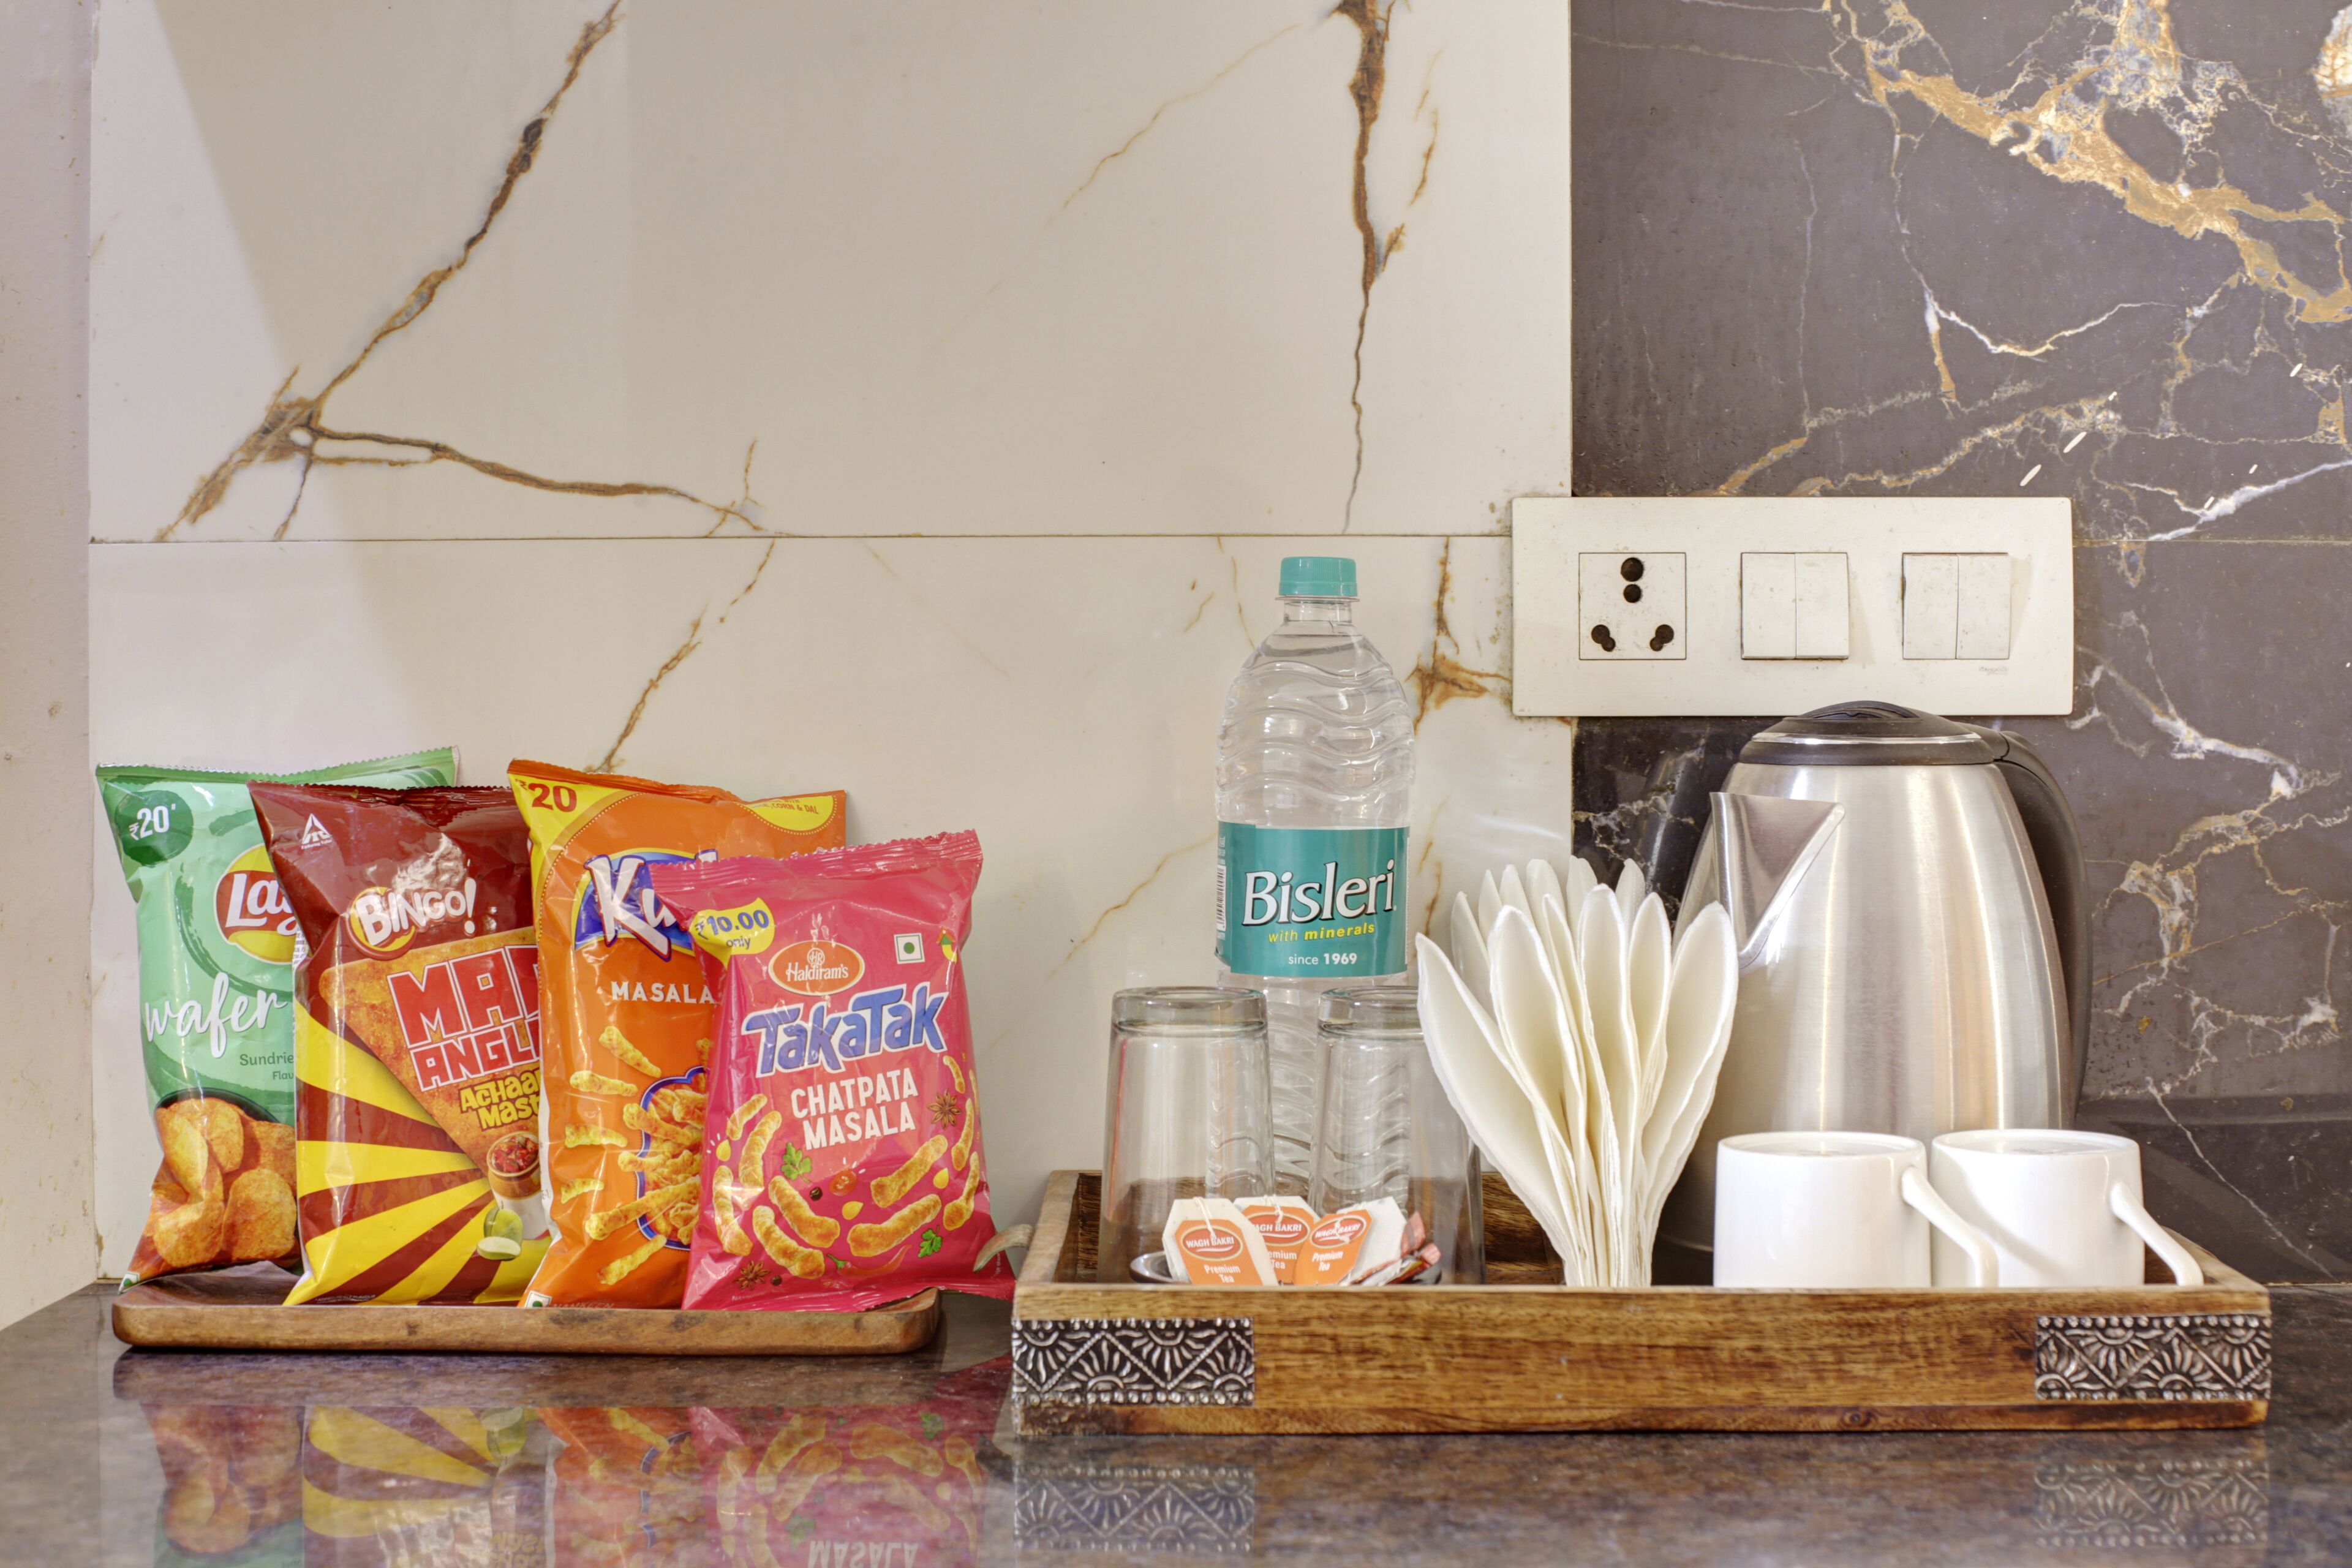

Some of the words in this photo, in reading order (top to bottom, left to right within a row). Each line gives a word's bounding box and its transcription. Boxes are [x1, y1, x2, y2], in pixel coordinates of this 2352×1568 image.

[804, 804, 819, 815] DAL
[1242, 859, 1395, 926] Bisleri
[355, 876, 477, 946] BINGO!
[1268, 931, 1298, 943] with
[1304, 922, 1375, 940] minerals
[726, 936, 751, 949] only
[1288, 955, 1319, 965] since
[1323, 953, 1357, 965] 1969
[785, 960, 849, 982] Haldiram's
[611, 981, 715, 1005] MASALA
[145, 971, 288, 1058] wafer
[791, 1068, 919, 1118] CHATPATA
[803, 1101, 916, 1151] MASALA
[1185, 1238, 1210, 1248] WAGH
[1211, 1236, 1235, 1246] BAKRI
[1311, 1251, 1344, 1262] Premium
[1204, 1264, 1241, 1275] Premium
[1318, 1262, 1331, 1272] Tea
[1219, 1274, 1235, 1283] Tea
